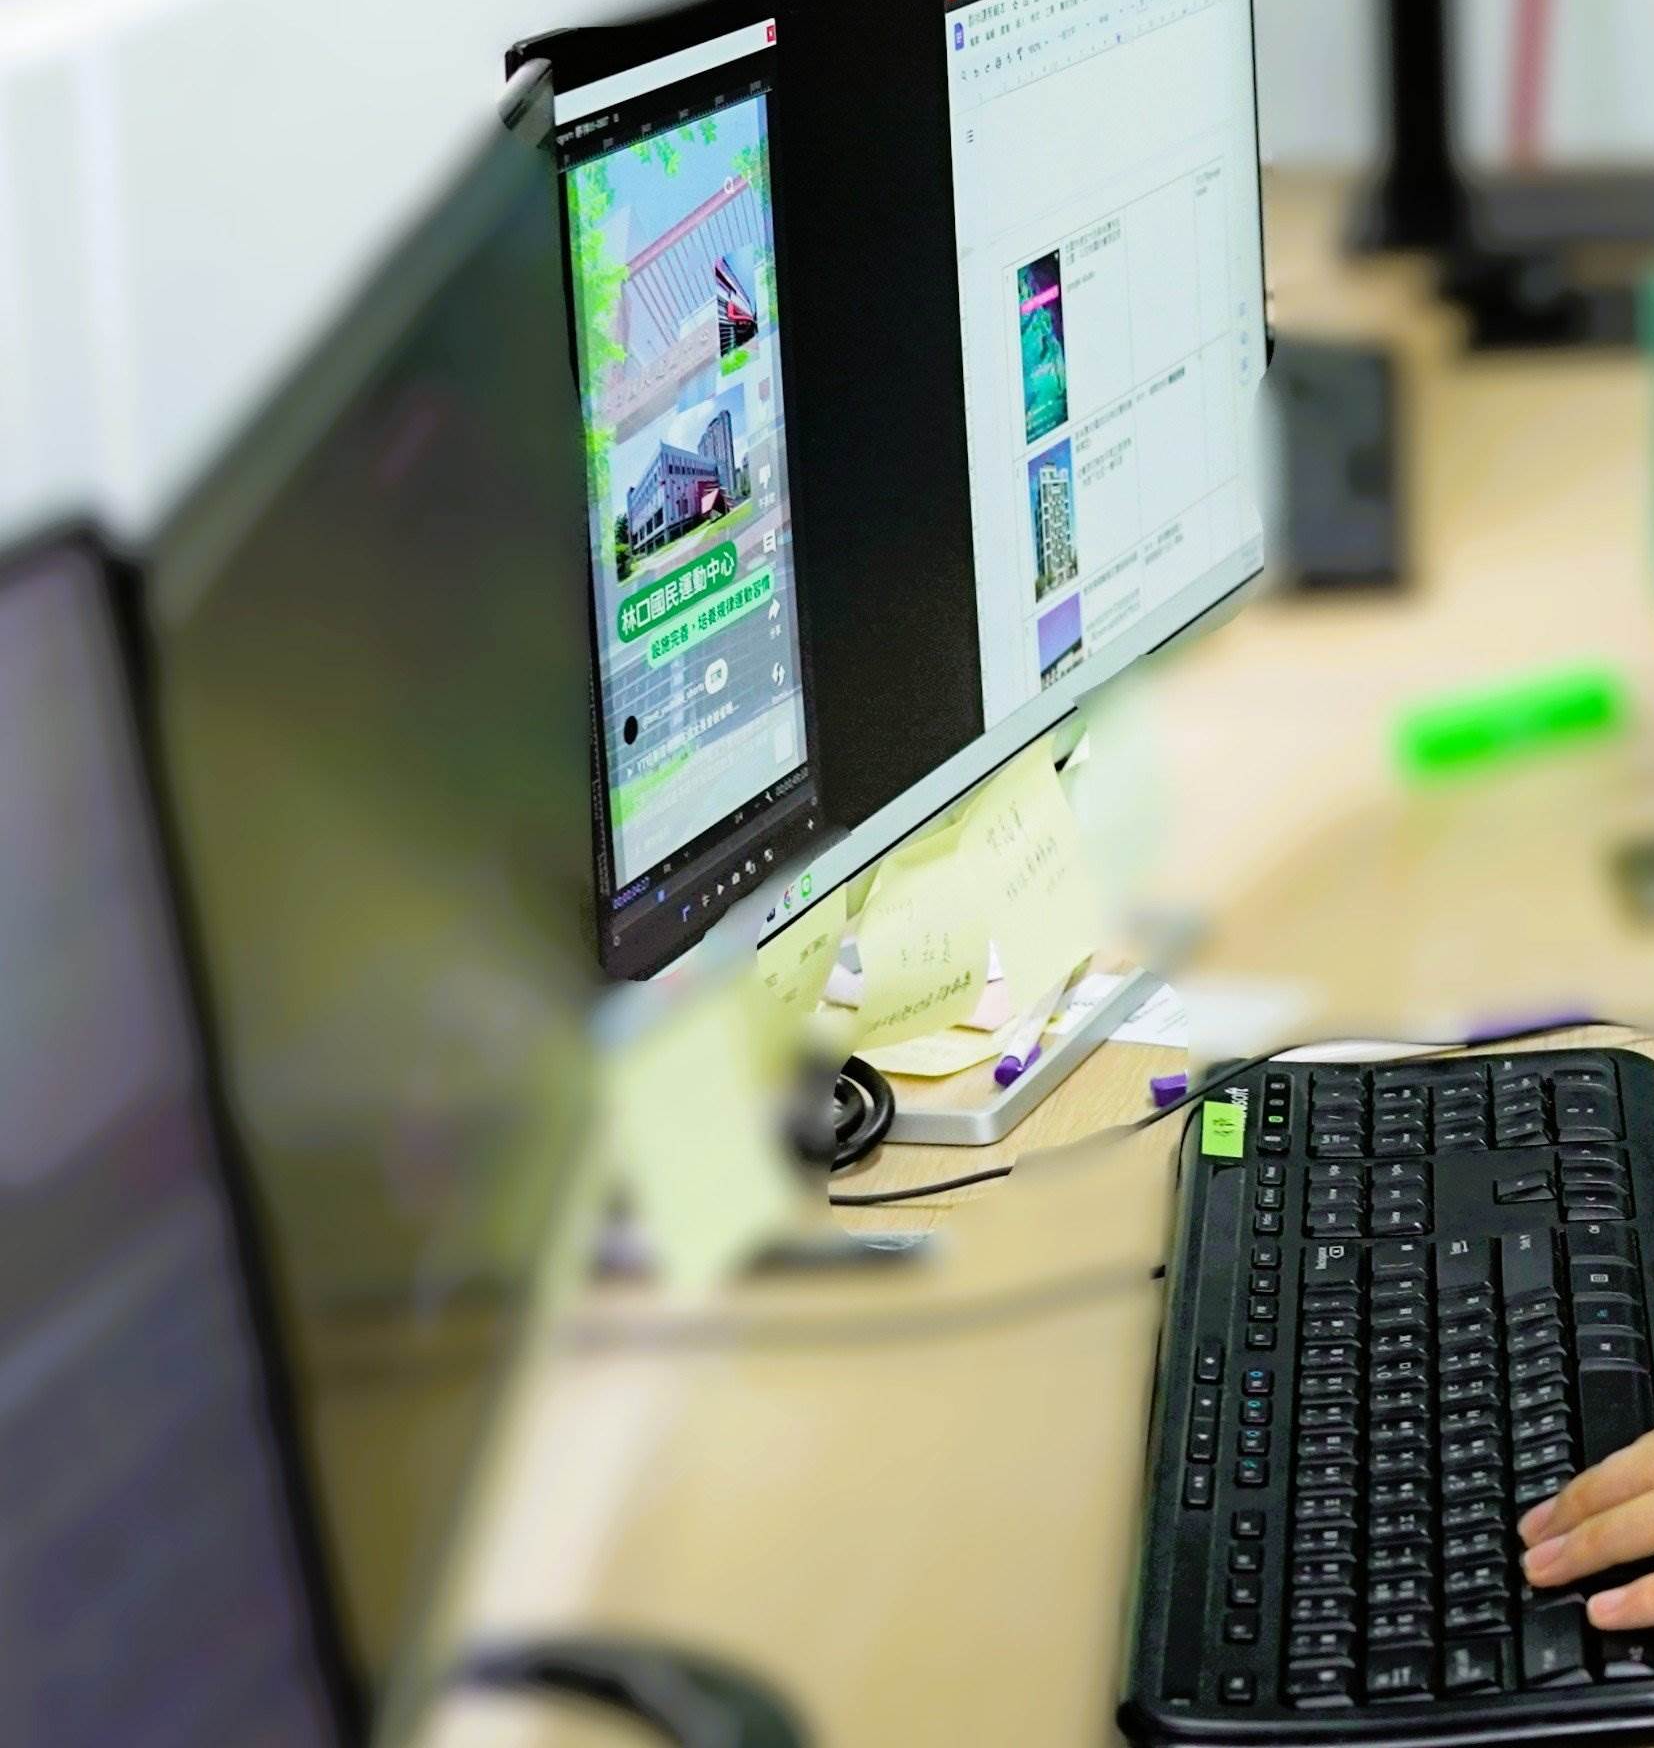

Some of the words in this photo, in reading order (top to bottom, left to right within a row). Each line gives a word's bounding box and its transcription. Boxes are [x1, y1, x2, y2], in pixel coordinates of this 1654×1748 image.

[621, 551, 735, 636] 林口國民運動中心
